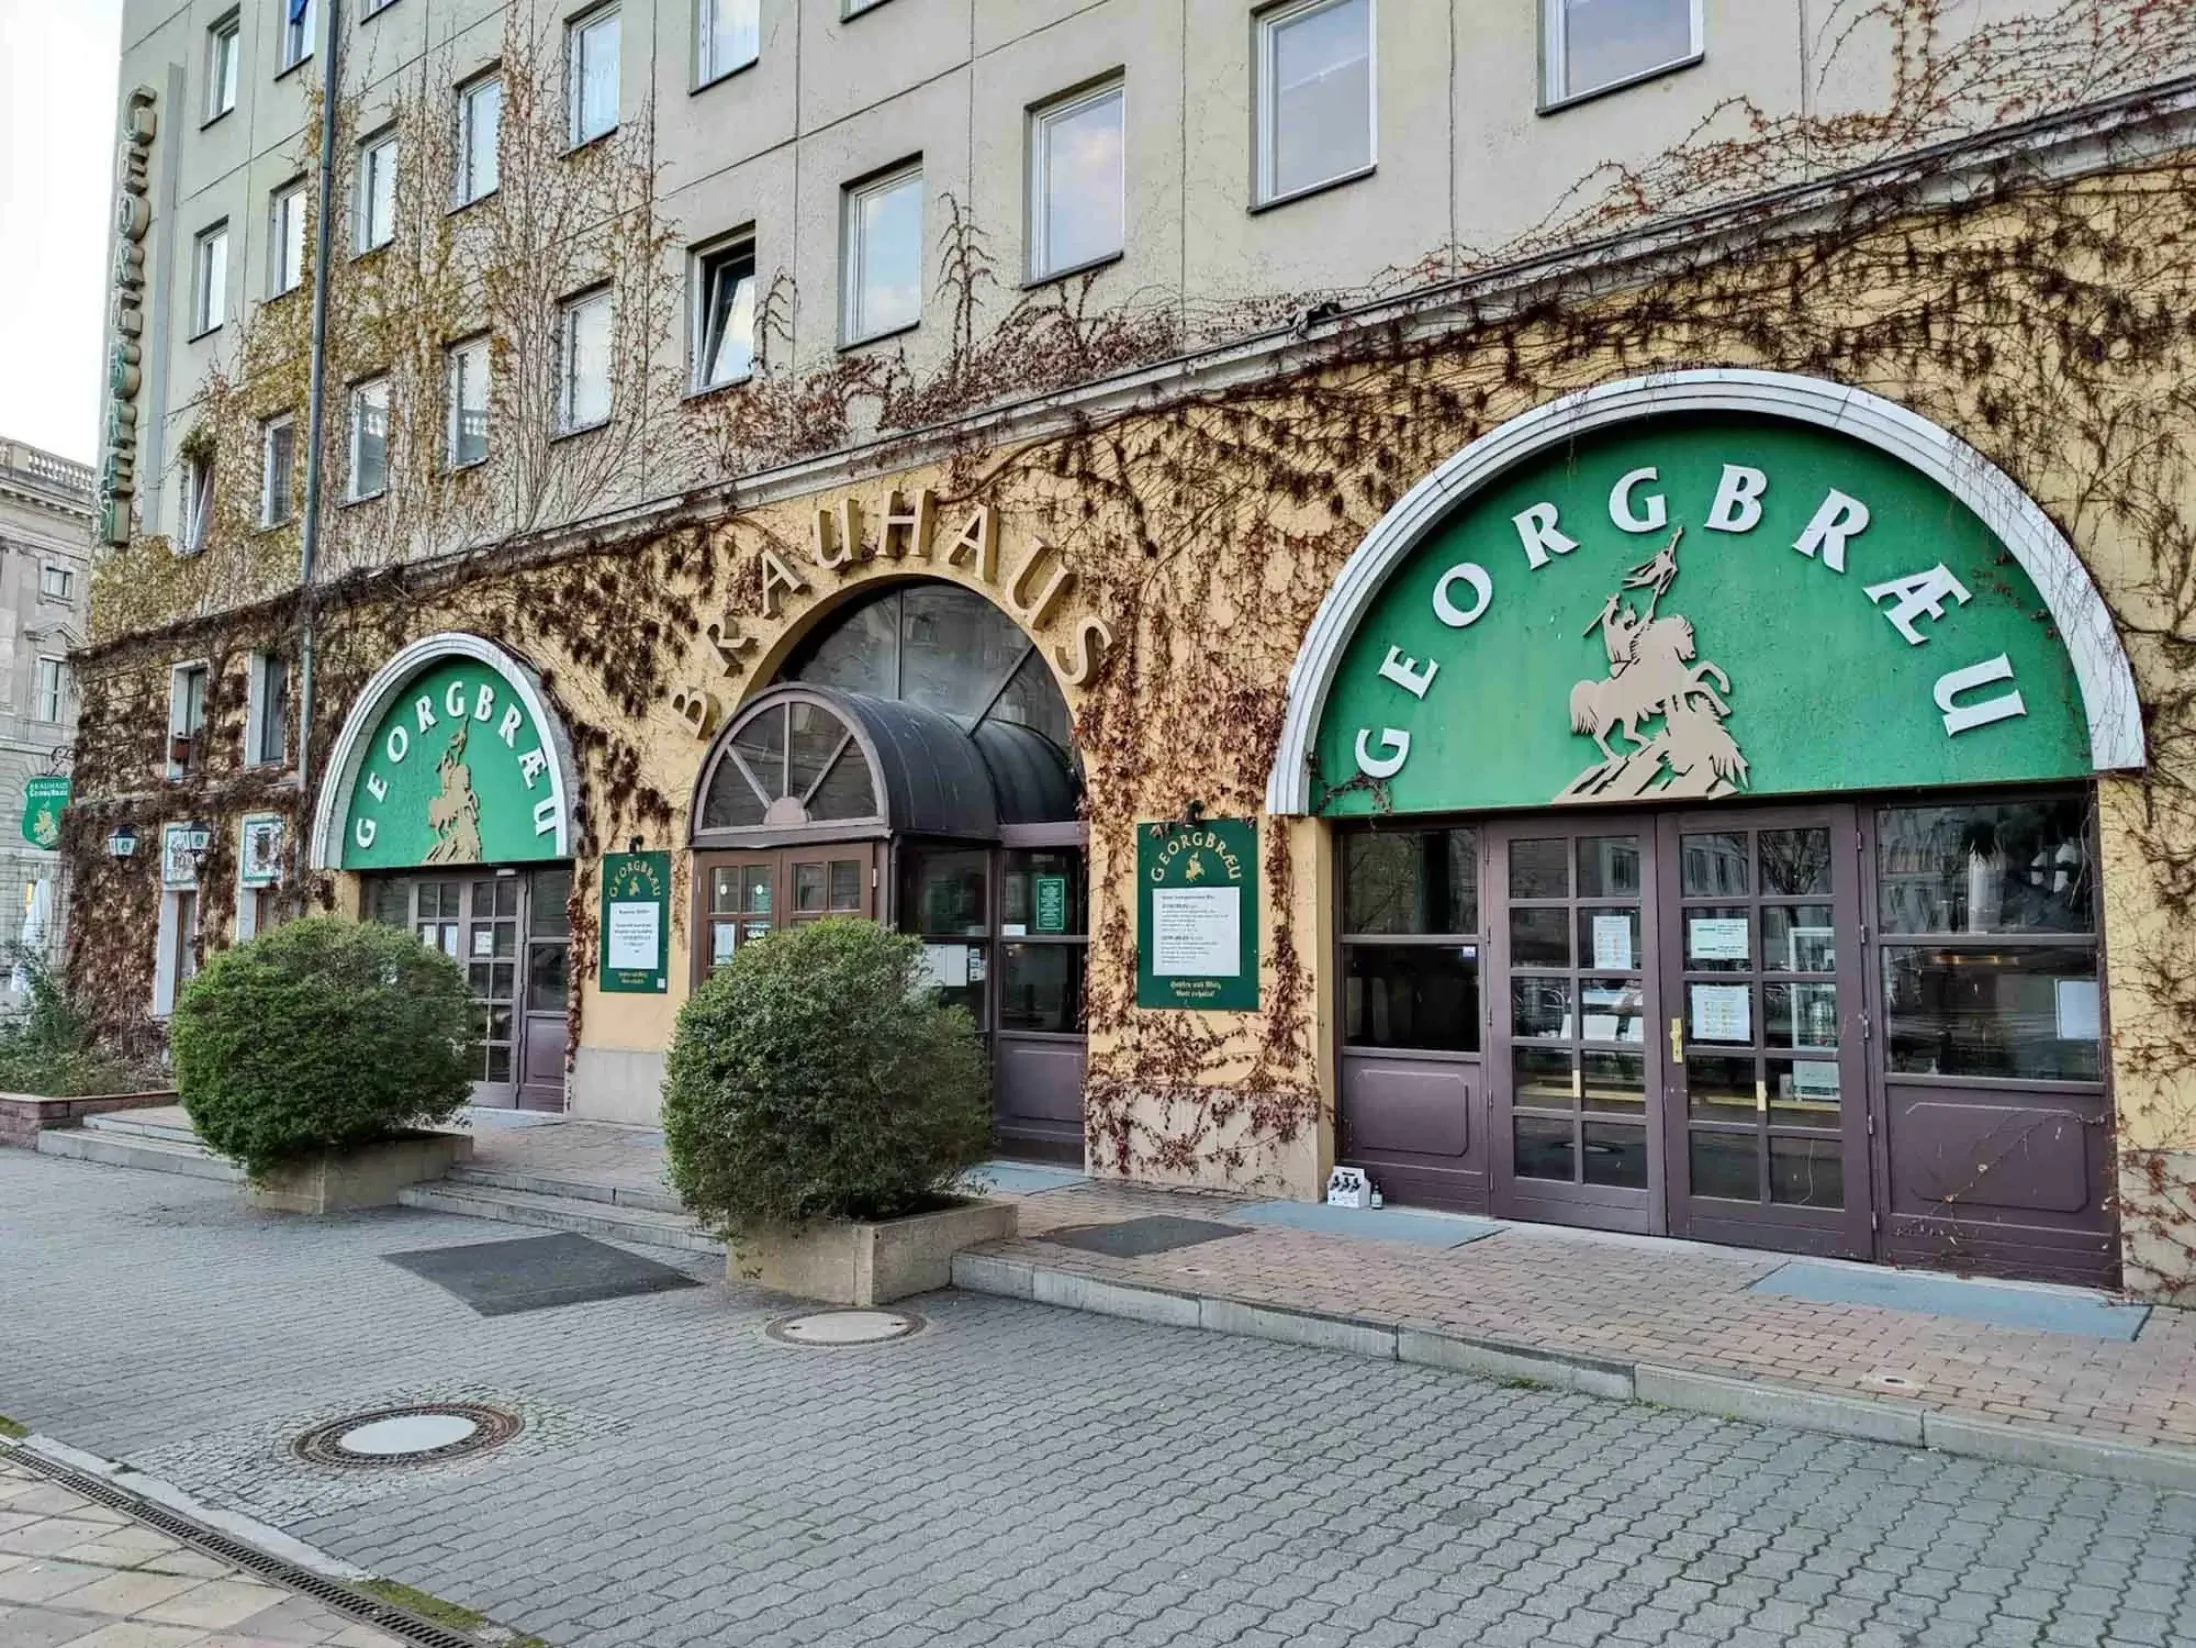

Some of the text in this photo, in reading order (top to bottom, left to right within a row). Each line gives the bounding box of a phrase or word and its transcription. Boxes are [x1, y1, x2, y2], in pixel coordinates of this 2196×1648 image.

[669, 488, 1118, 741] BRAUHAUS
[1354, 463, 2028, 779] GEORGBRÆU
[355, 680, 557, 849] GEORGBRÆU
[1150, 832, 1242, 882] GEORGBRÆU
